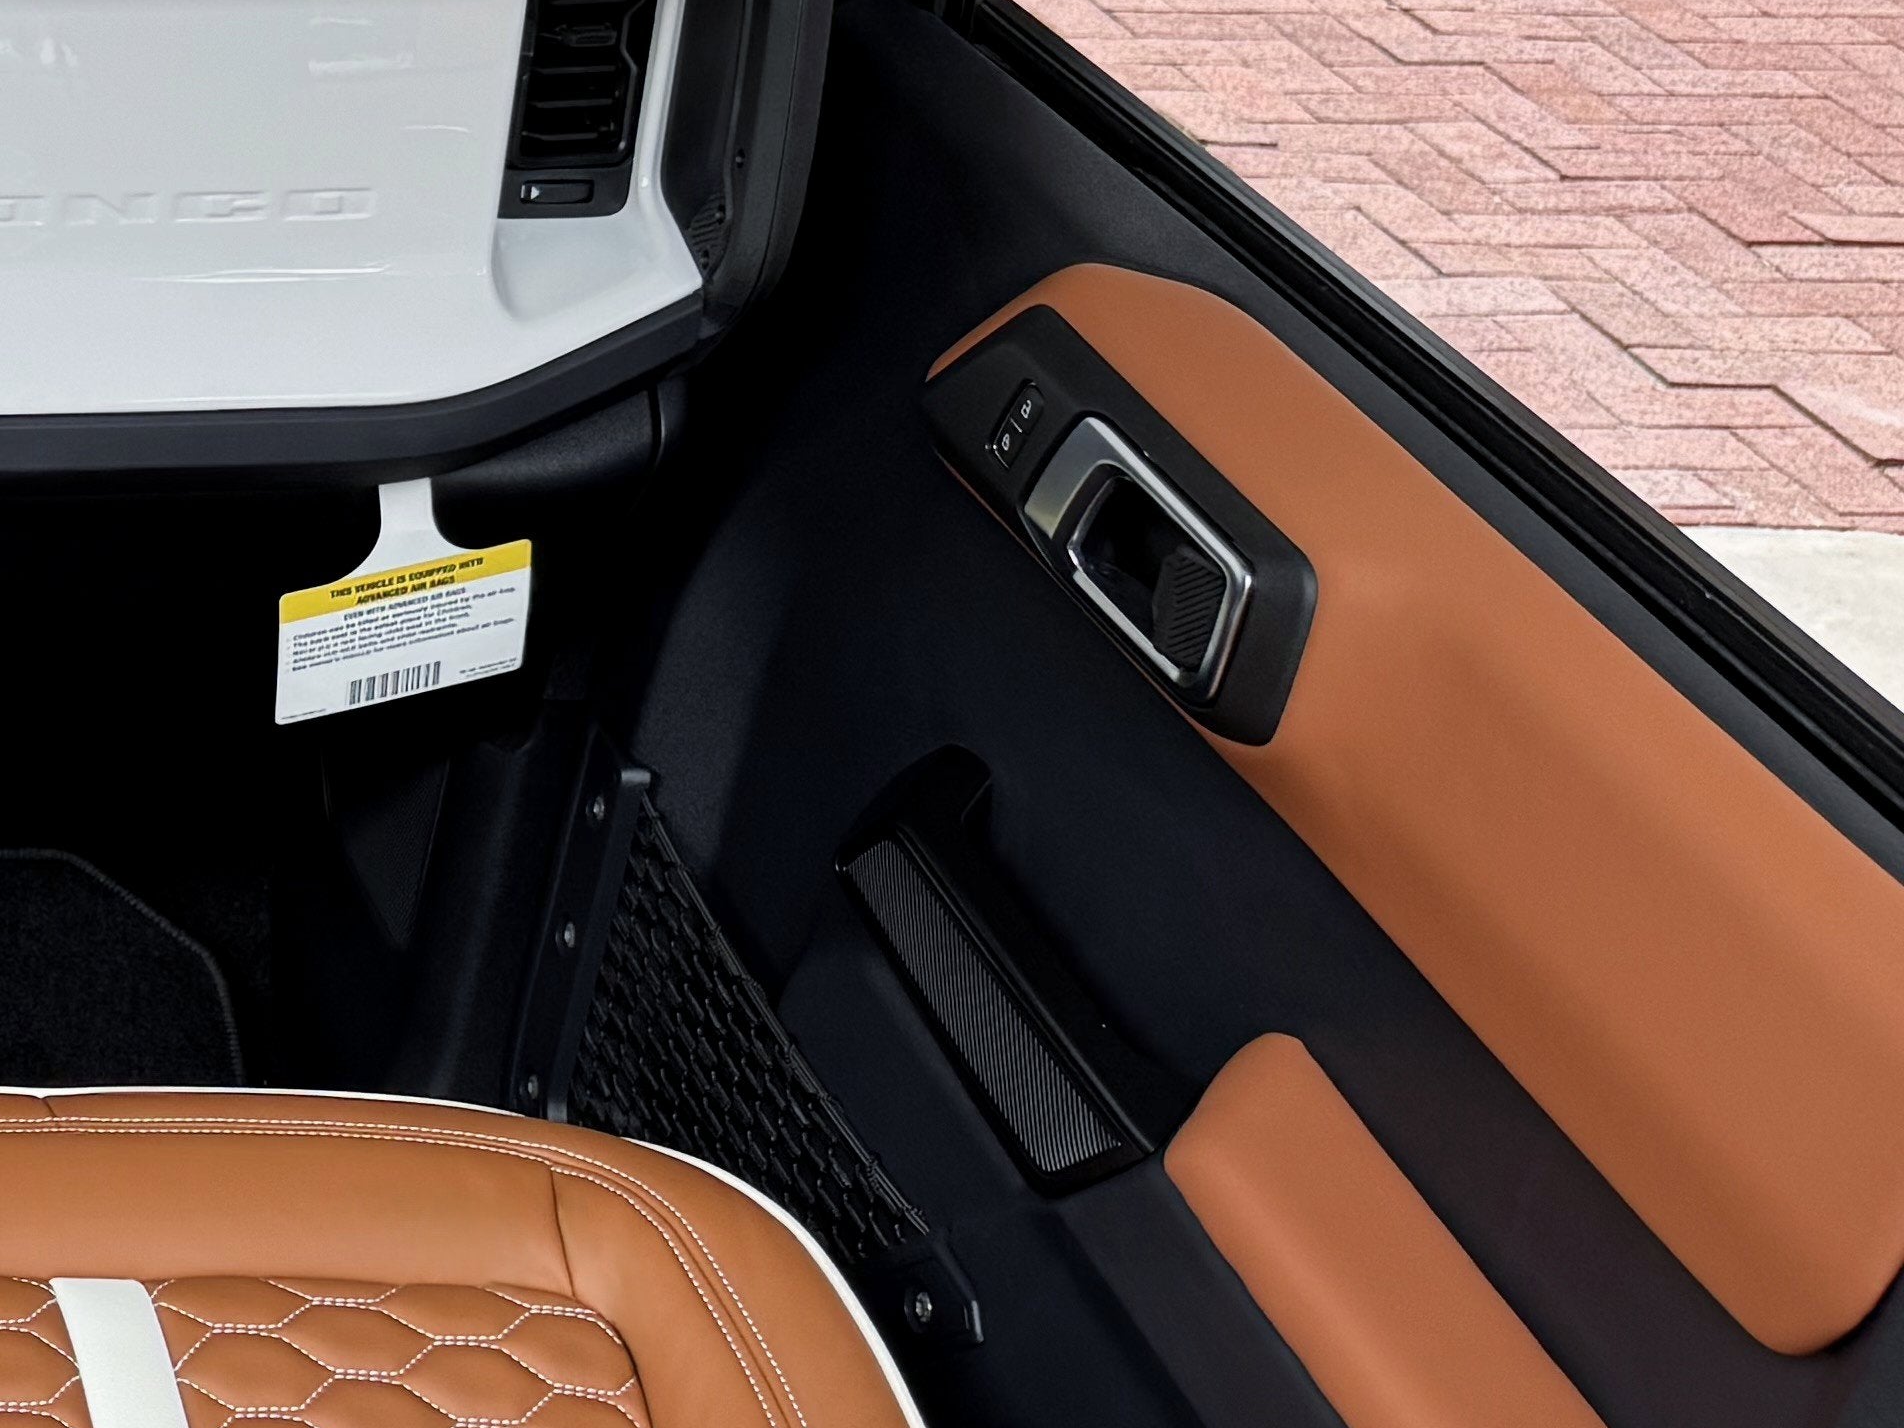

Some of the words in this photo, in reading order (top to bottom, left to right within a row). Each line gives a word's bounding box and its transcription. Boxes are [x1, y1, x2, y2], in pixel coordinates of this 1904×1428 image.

[330, 587, 352, 599] THIS
[354, 577, 394, 593] VEHICLE
[396, 574, 406, 584] IS
[409, 582, 428, 593] AIR
